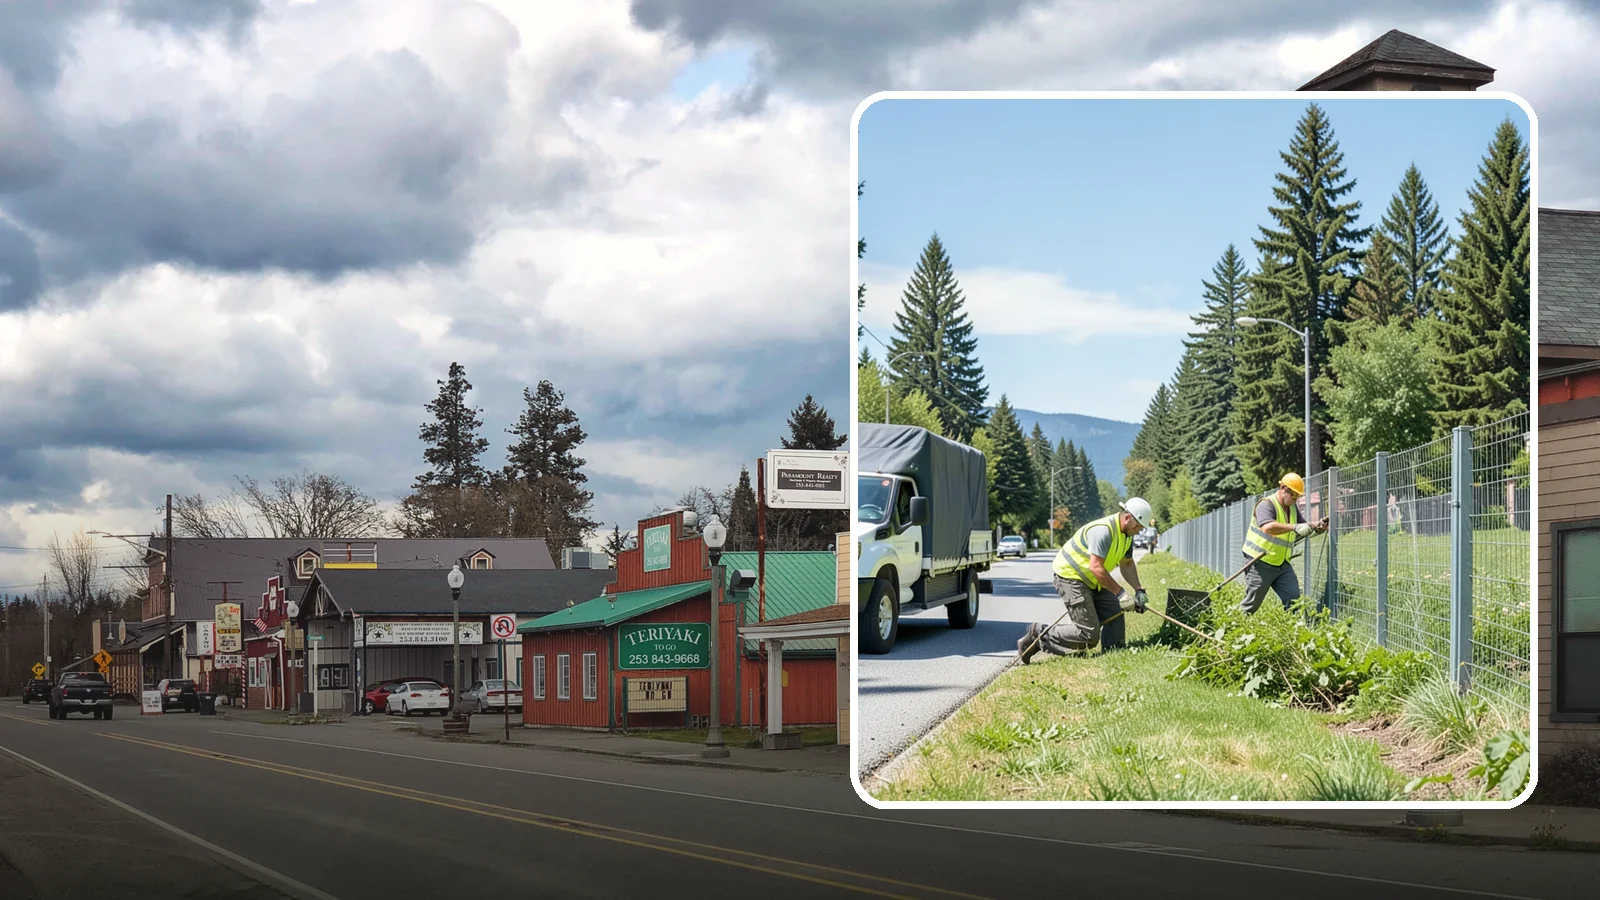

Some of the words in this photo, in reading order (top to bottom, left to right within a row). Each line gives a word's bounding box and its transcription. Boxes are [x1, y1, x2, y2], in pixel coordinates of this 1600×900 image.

[817, 472, 839, 480] REALTY
[624, 628, 702, 646] TERIYAKI
[629, 655, 648, 664] 253
[651, 654, 700, 664] 843-9668
